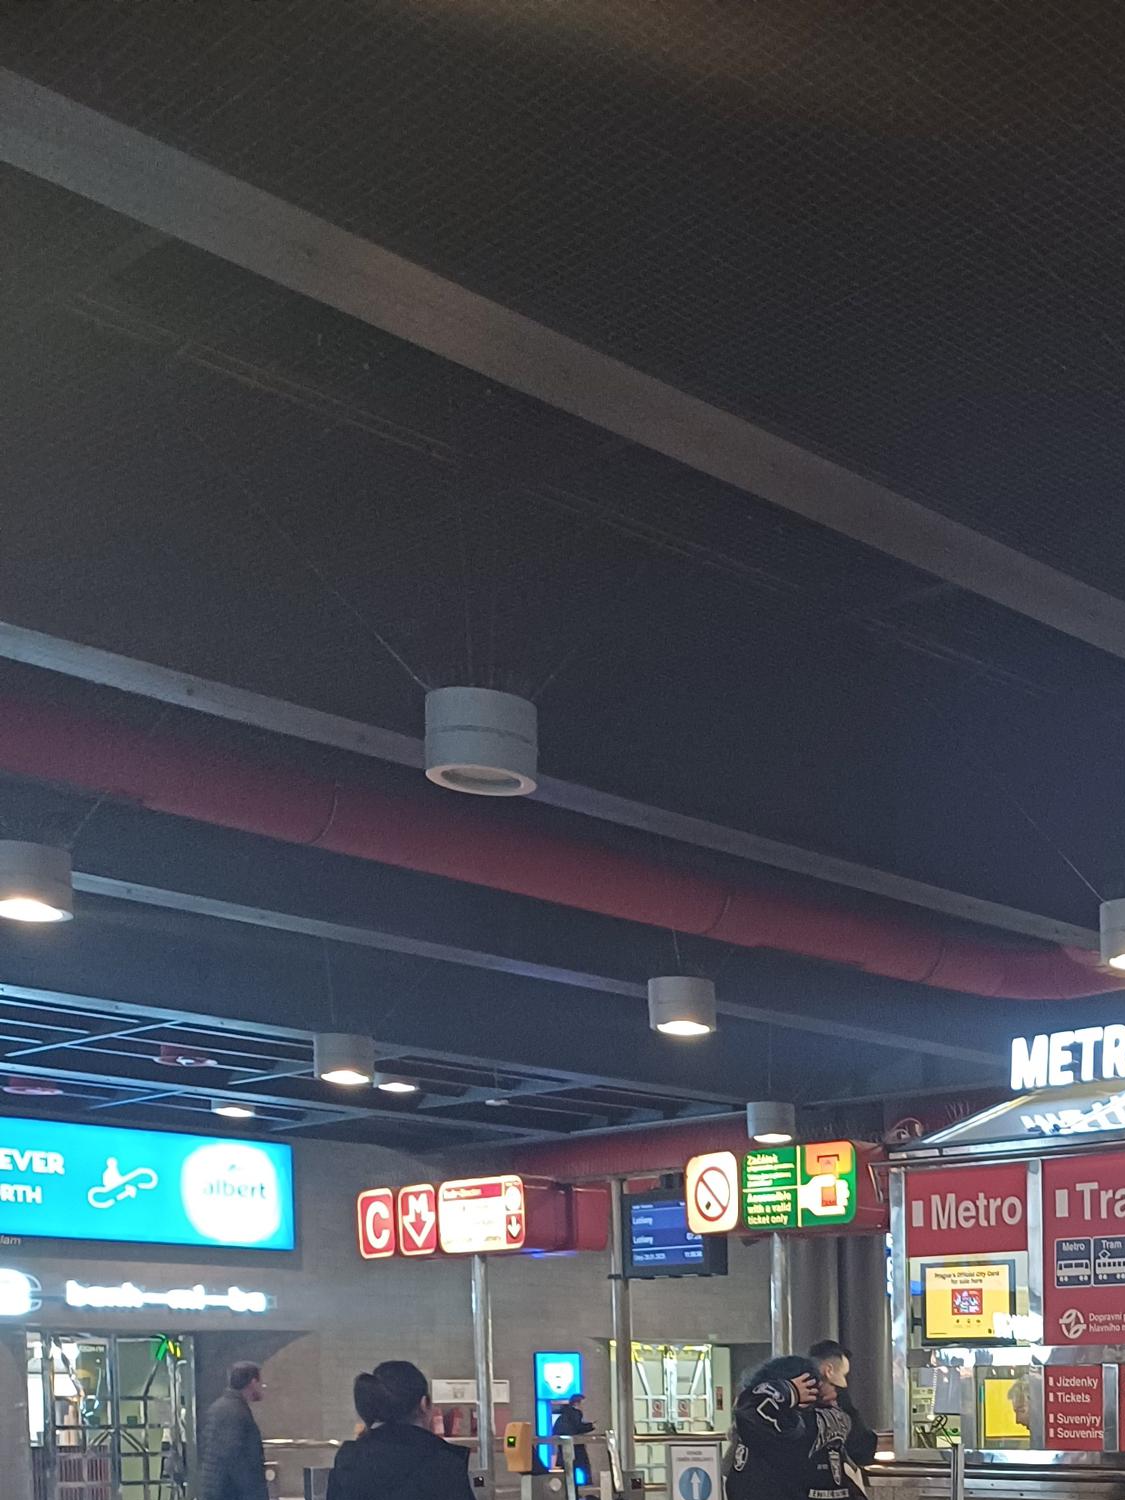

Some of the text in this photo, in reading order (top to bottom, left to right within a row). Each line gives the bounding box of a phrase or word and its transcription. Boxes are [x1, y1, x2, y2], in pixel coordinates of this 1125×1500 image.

[203, 1179, 267, 1199] albert
[930, 1192, 1023, 1230] Metro
[771, 1213, 788, 1225] only
[366, 1201, 391, 1249] C
[1062, 1242, 1085, 1251] Metro
[1102, 1239, 1122, 1249] Tram
[1089, 1312, 1123, 1322] Dopravní
[1089, 1322, 1121, 1332] hlavního
[1056, 1376, 1098, 1389] Jízdenky
[1057, 1392, 1091, 1403] Tickets
[1057, 1413, 1101, 1427] Suvenýry
[1057, 1428, 1104, 1439] Souvenirs
